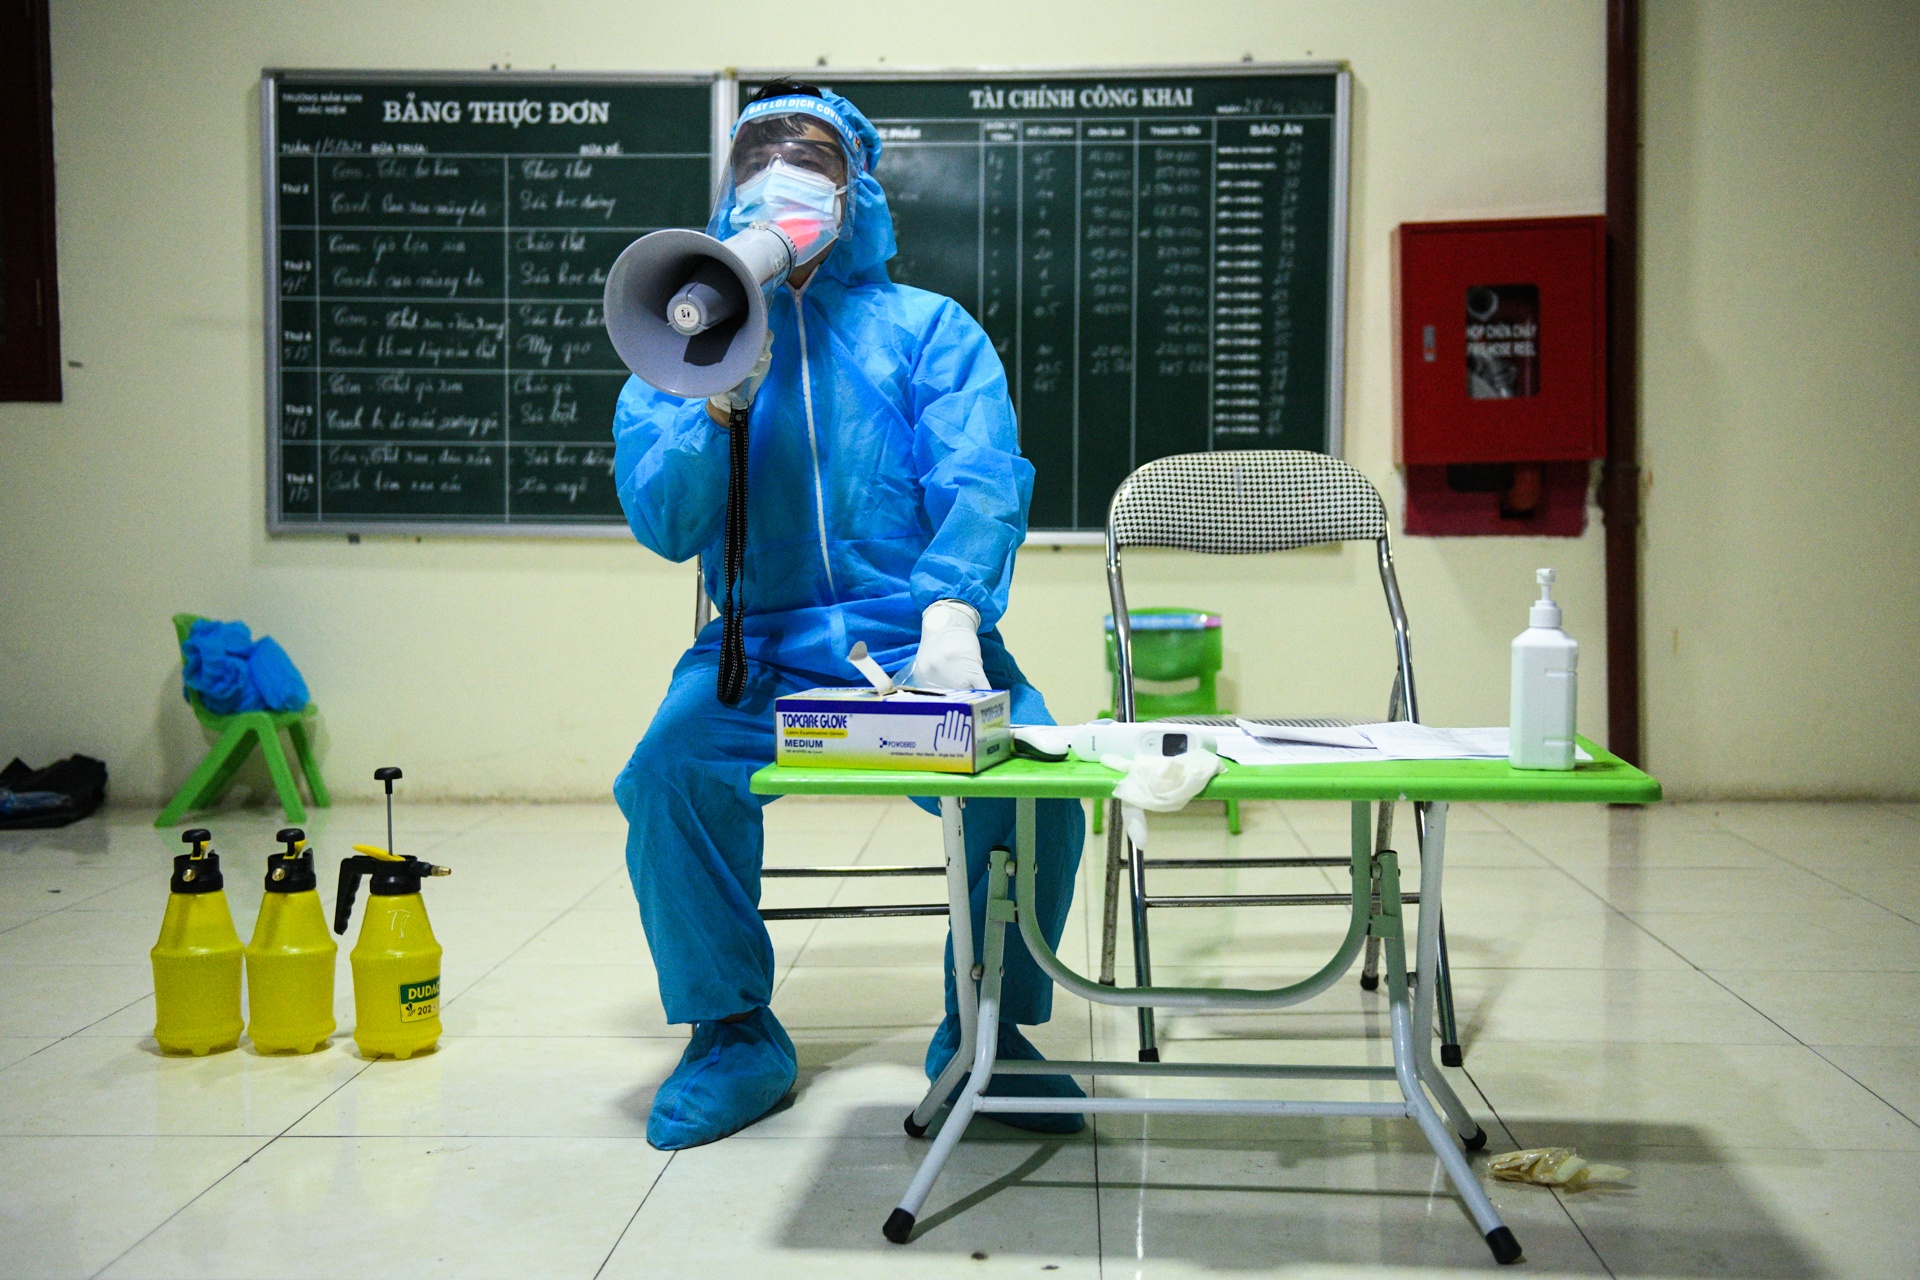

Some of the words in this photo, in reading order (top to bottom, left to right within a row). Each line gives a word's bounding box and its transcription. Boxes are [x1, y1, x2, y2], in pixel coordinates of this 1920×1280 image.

[969, 86, 1004, 109] TÀI
[1008, 85, 1075, 109] CHÍNH
[1079, 84, 1137, 108] CÔNG
[1142, 87, 1194, 107] KHAI
[382, 91, 462, 123] BẢNG
[467, 98, 543, 129] THỰC
[548, 98, 610, 124] ĐƠN
[782, 714, 819, 729] TOPCARE
[820, 714, 848, 729] GLOVE
[785, 739, 824, 749] MEDIUM
[417, 1004, 432, 1016] 202
